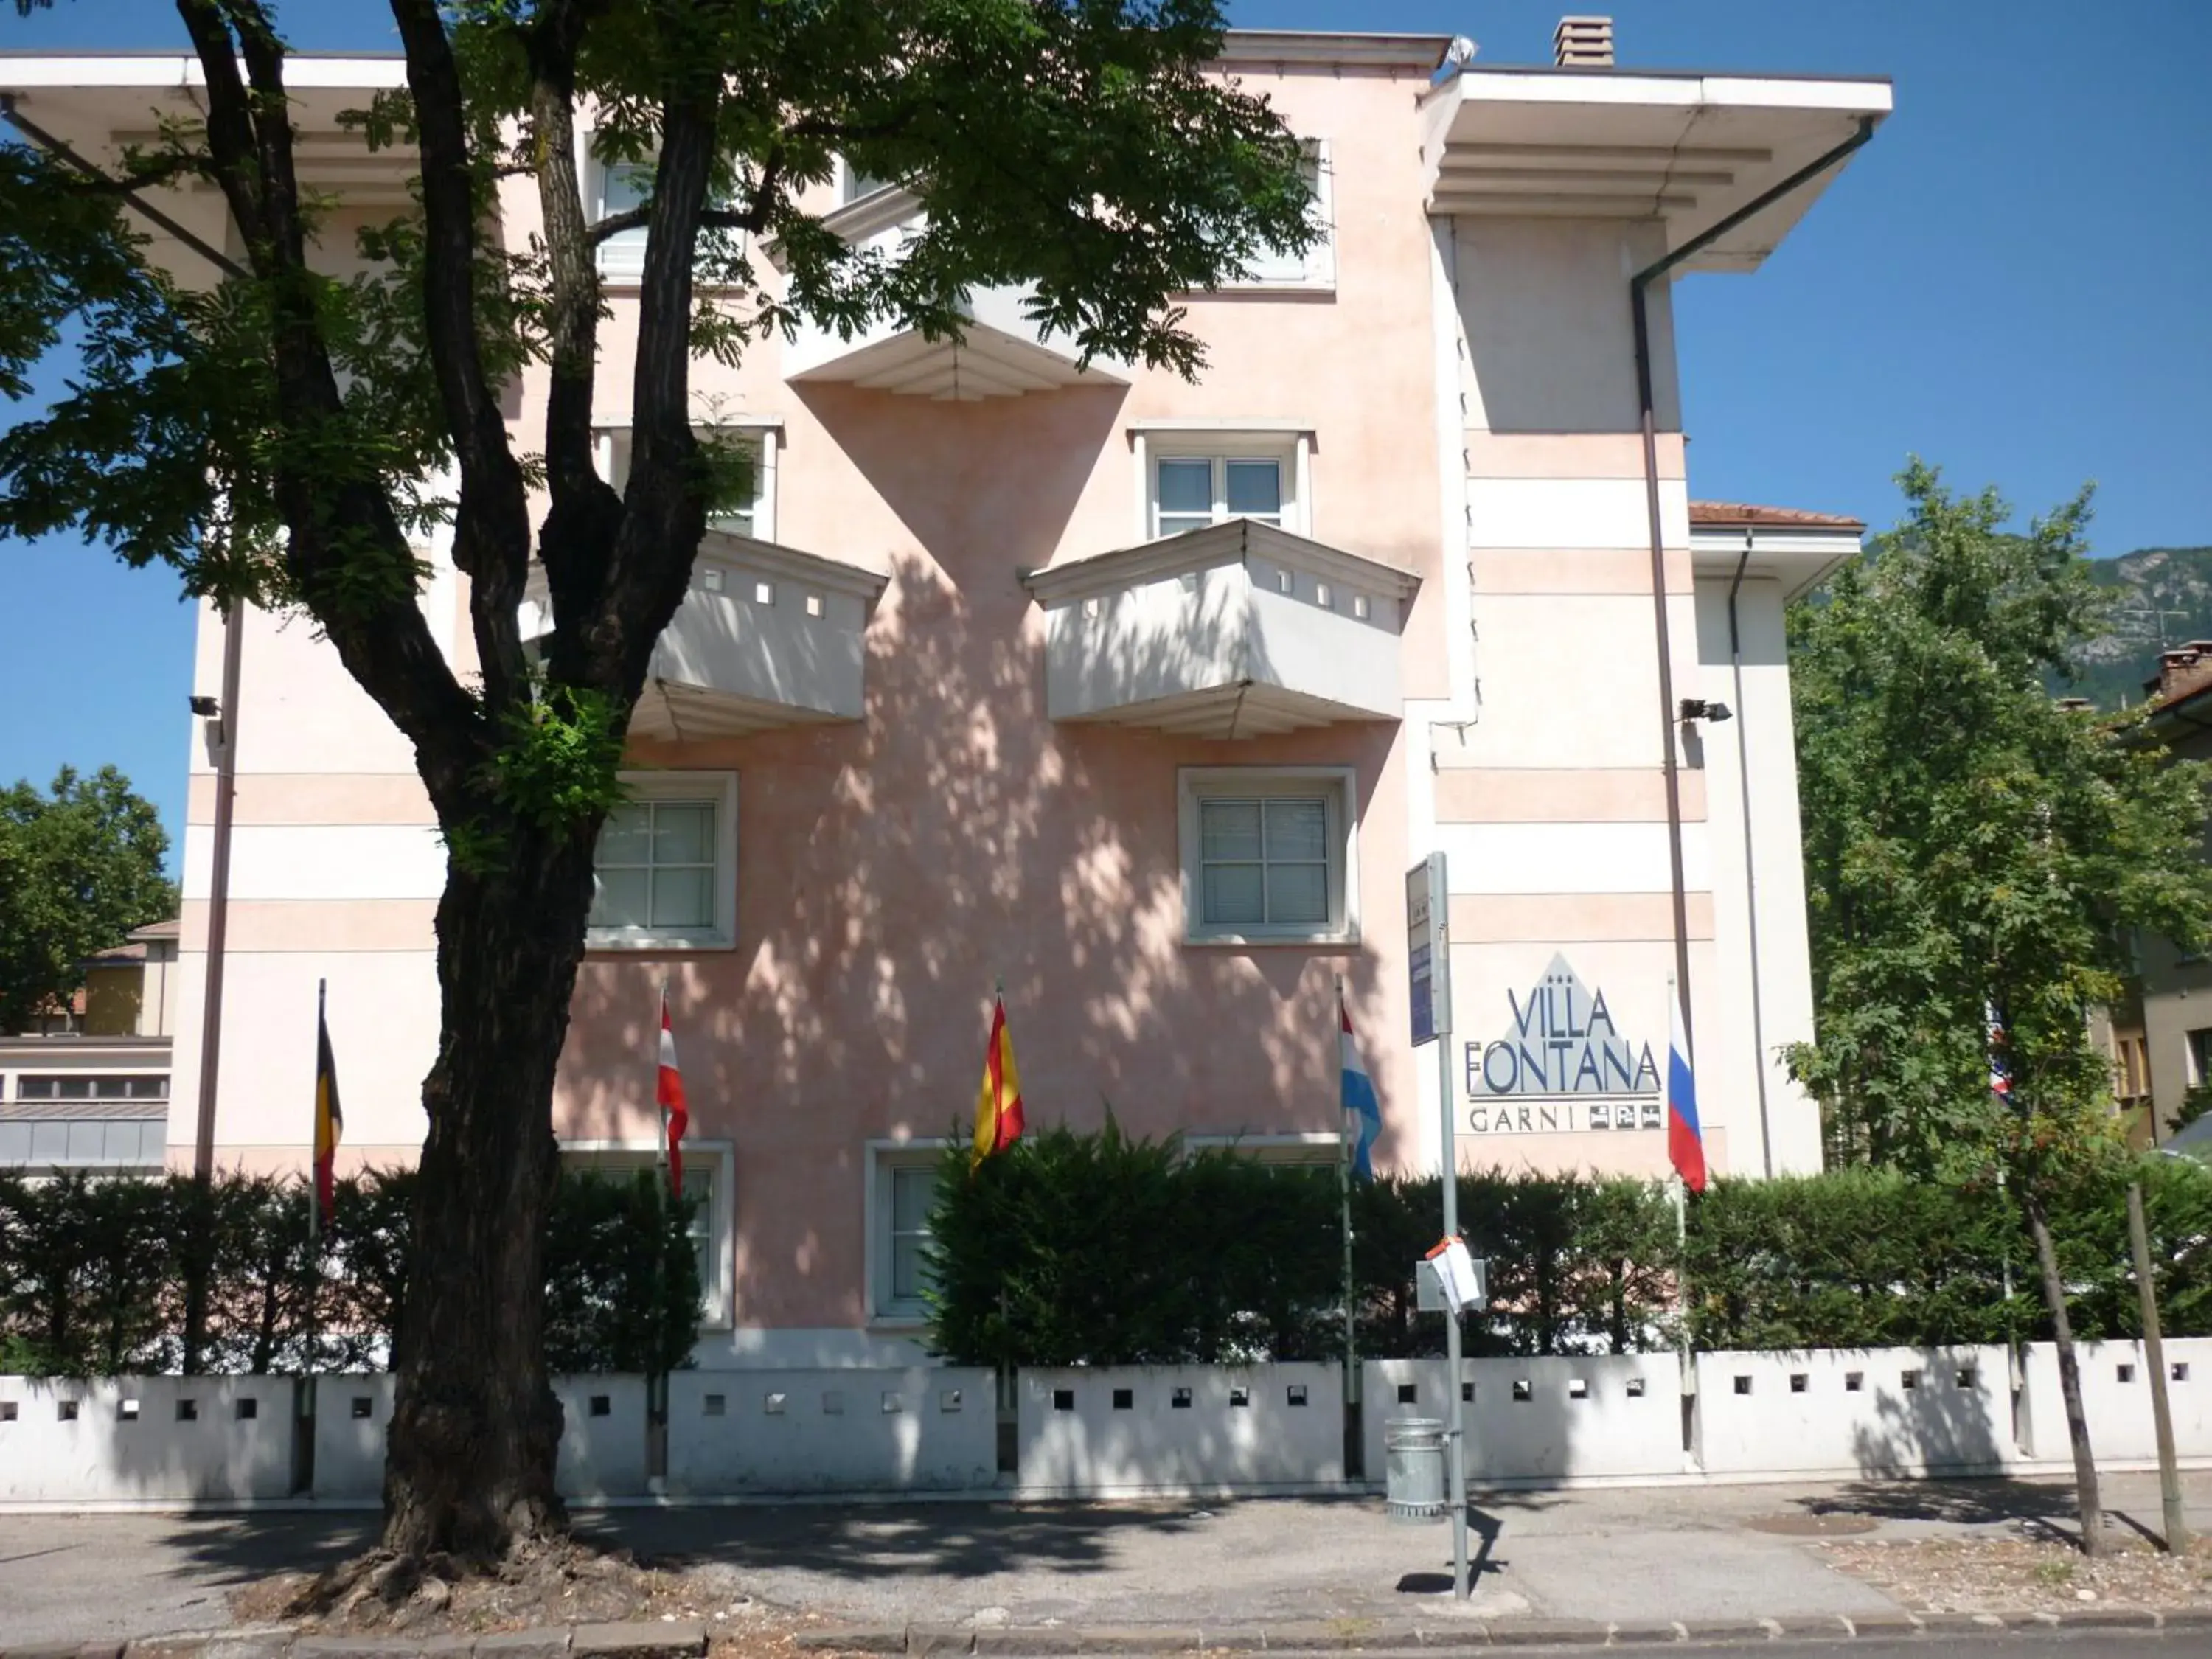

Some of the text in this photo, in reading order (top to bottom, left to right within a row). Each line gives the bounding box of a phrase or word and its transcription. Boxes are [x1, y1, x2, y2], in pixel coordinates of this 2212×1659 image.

[1507, 986, 1615, 1038] VILLA
[1465, 1039, 1662, 1093] FONTANA
[1470, 1106, 1573, 1132] GARNI
